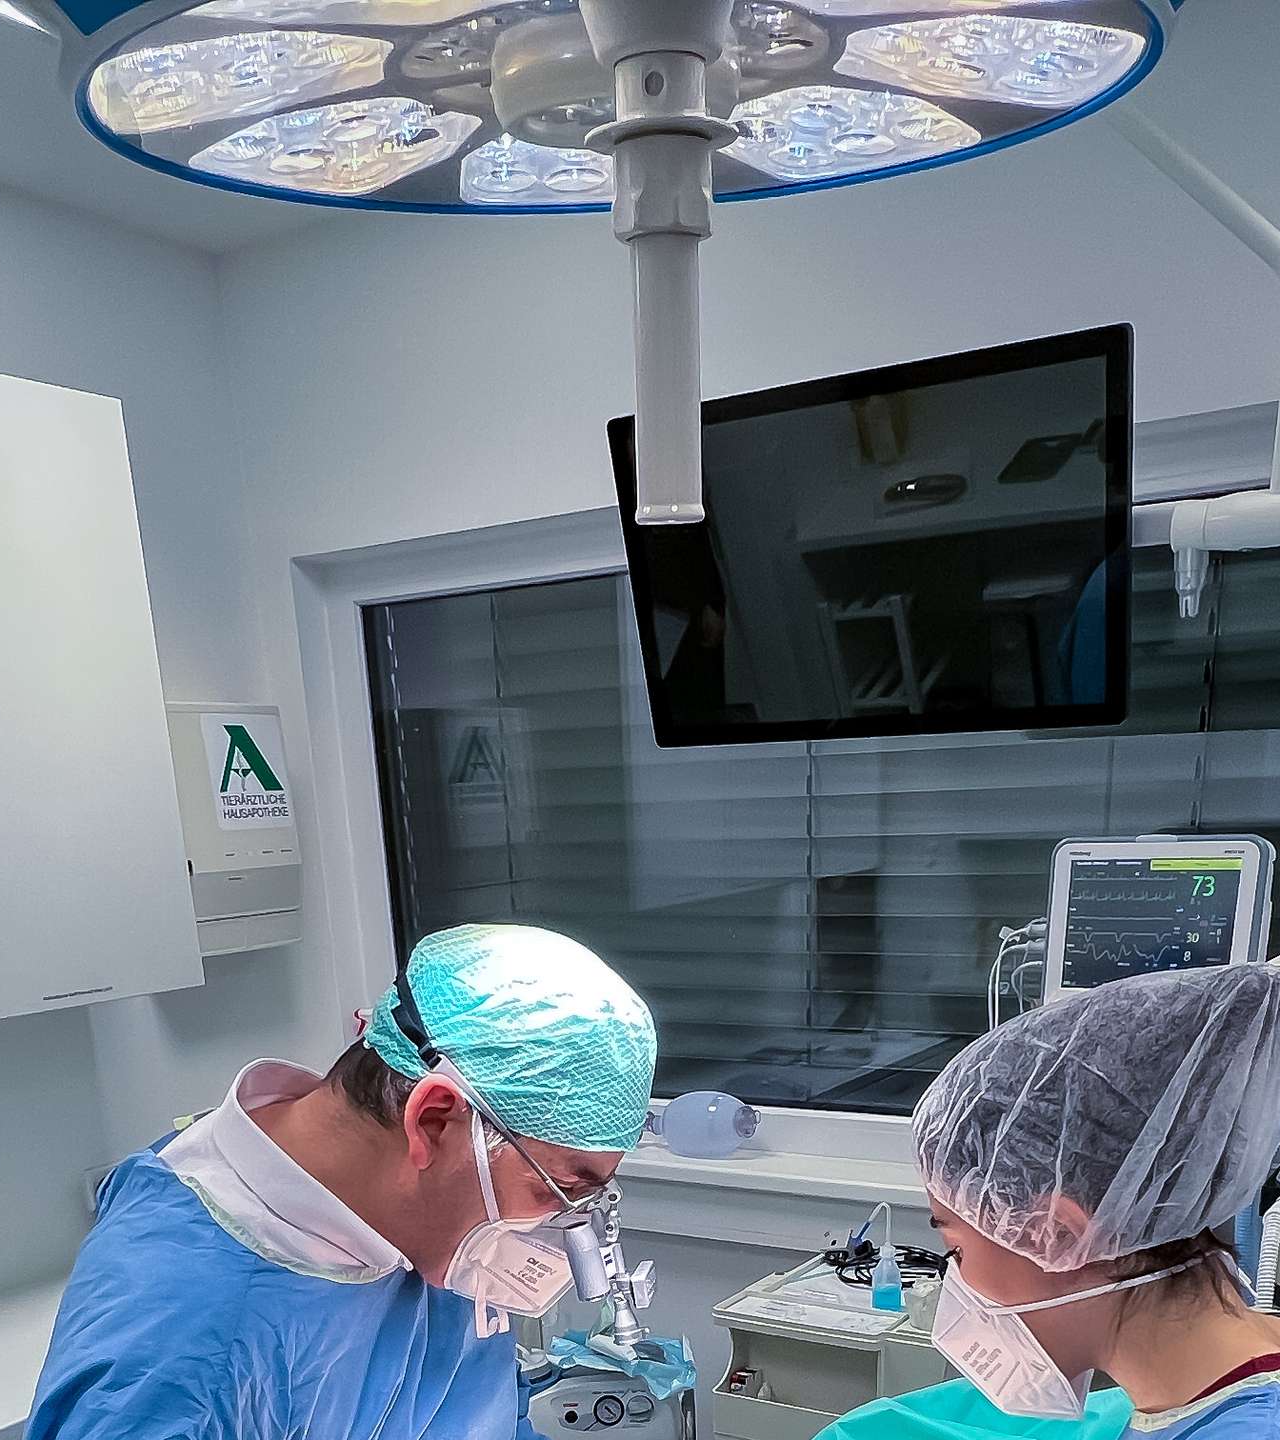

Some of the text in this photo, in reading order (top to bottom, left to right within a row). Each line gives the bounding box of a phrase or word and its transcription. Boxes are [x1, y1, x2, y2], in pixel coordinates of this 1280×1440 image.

[223, 806, 289, 819] HAUSAPOTHEKE
[1192, 875, 1216, 897] 73
[1186, 931, 1200, 943] 30
